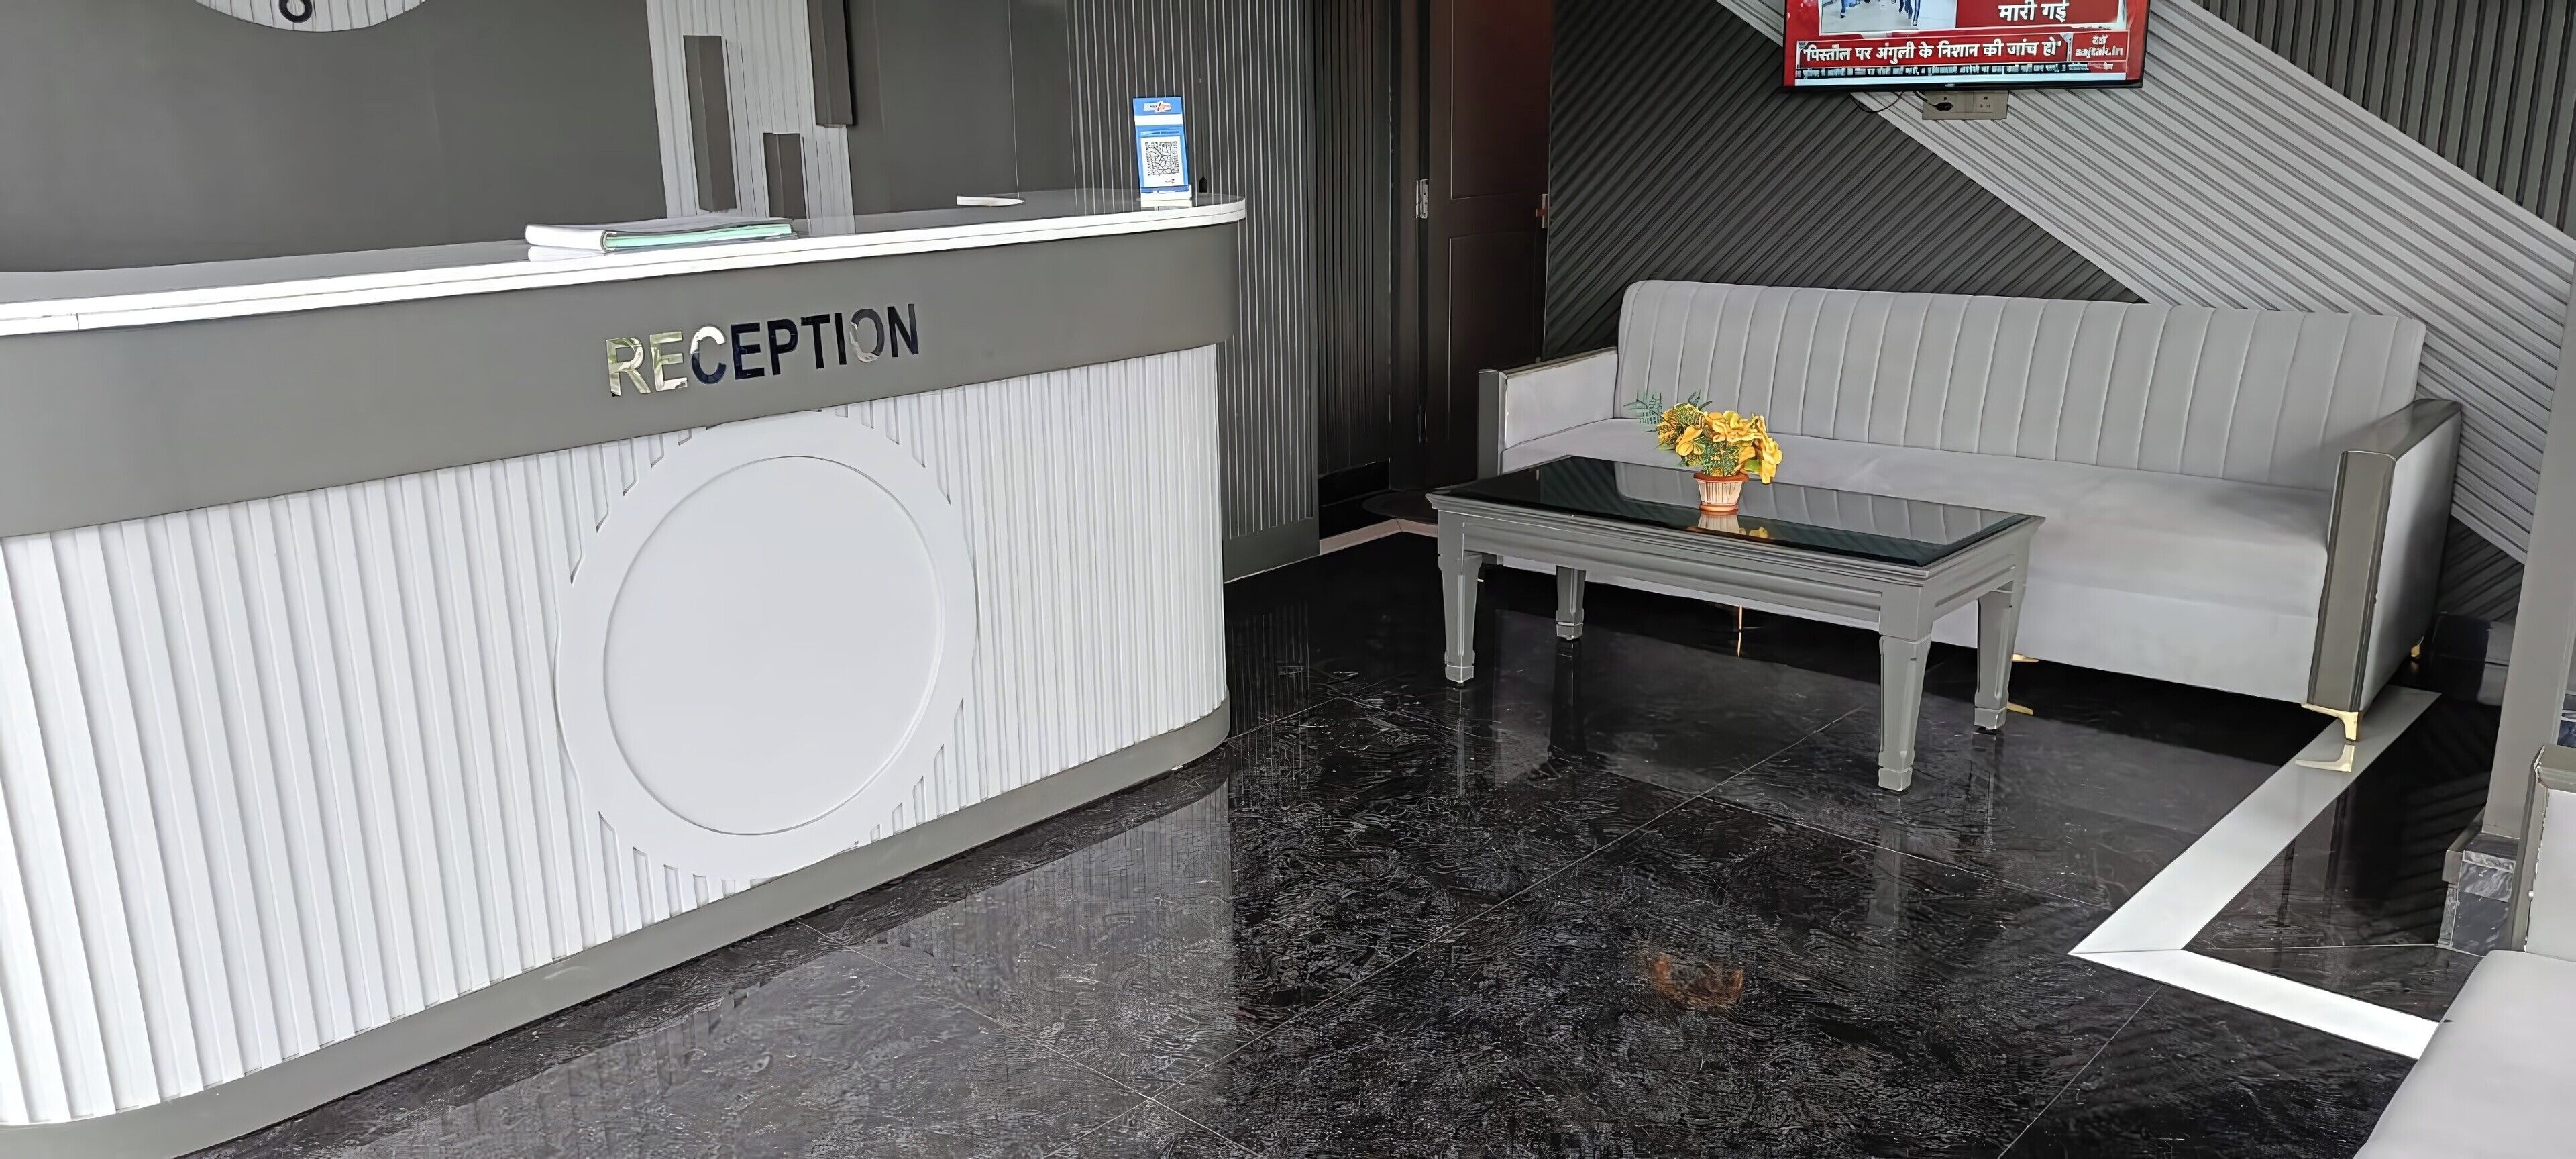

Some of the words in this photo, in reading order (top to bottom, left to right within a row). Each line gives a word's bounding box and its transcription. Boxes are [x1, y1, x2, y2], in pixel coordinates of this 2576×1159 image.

[1855, 47, 1872, 60] पर
[1876, 41, 1917, 64] अंगुली
[1918, 41, 1934, 58] के
[1936, 40, 1980, 58] निशान
[1983, 38, 2004, 56] की
[2007, 38, 2039, 56] जांच
[605, 303, 919, 397] RECEPTION
